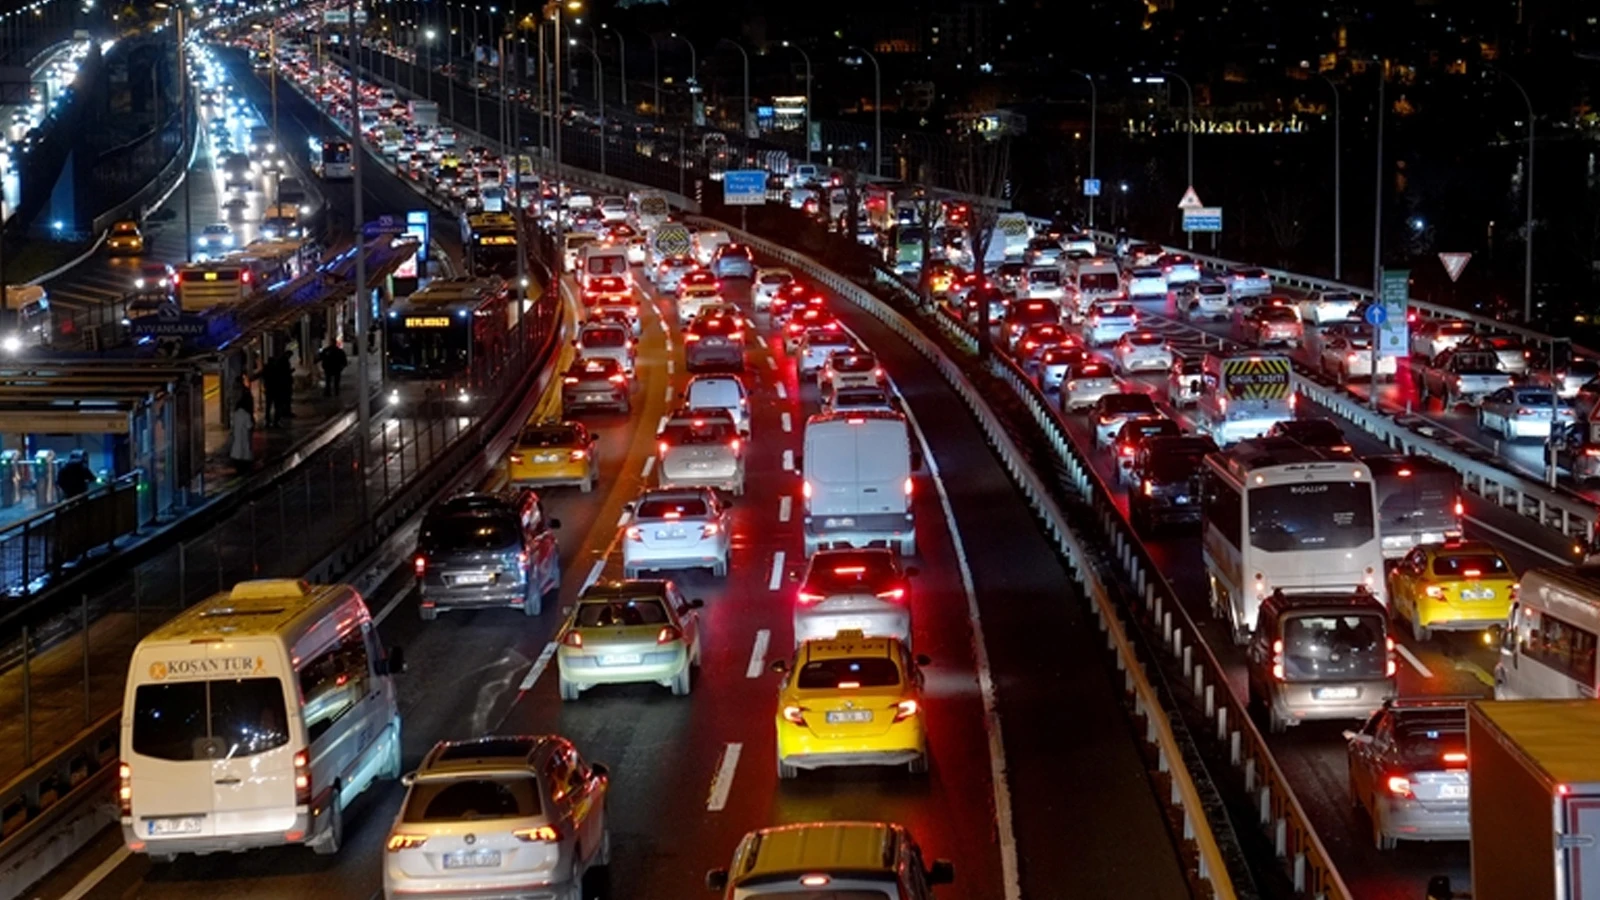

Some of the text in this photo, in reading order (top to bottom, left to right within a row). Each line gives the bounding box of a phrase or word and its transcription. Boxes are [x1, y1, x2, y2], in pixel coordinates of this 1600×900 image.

[1230, 374, 1252, 383] OKUL
[167, 657, 253, 674] KOŞAN TUR
